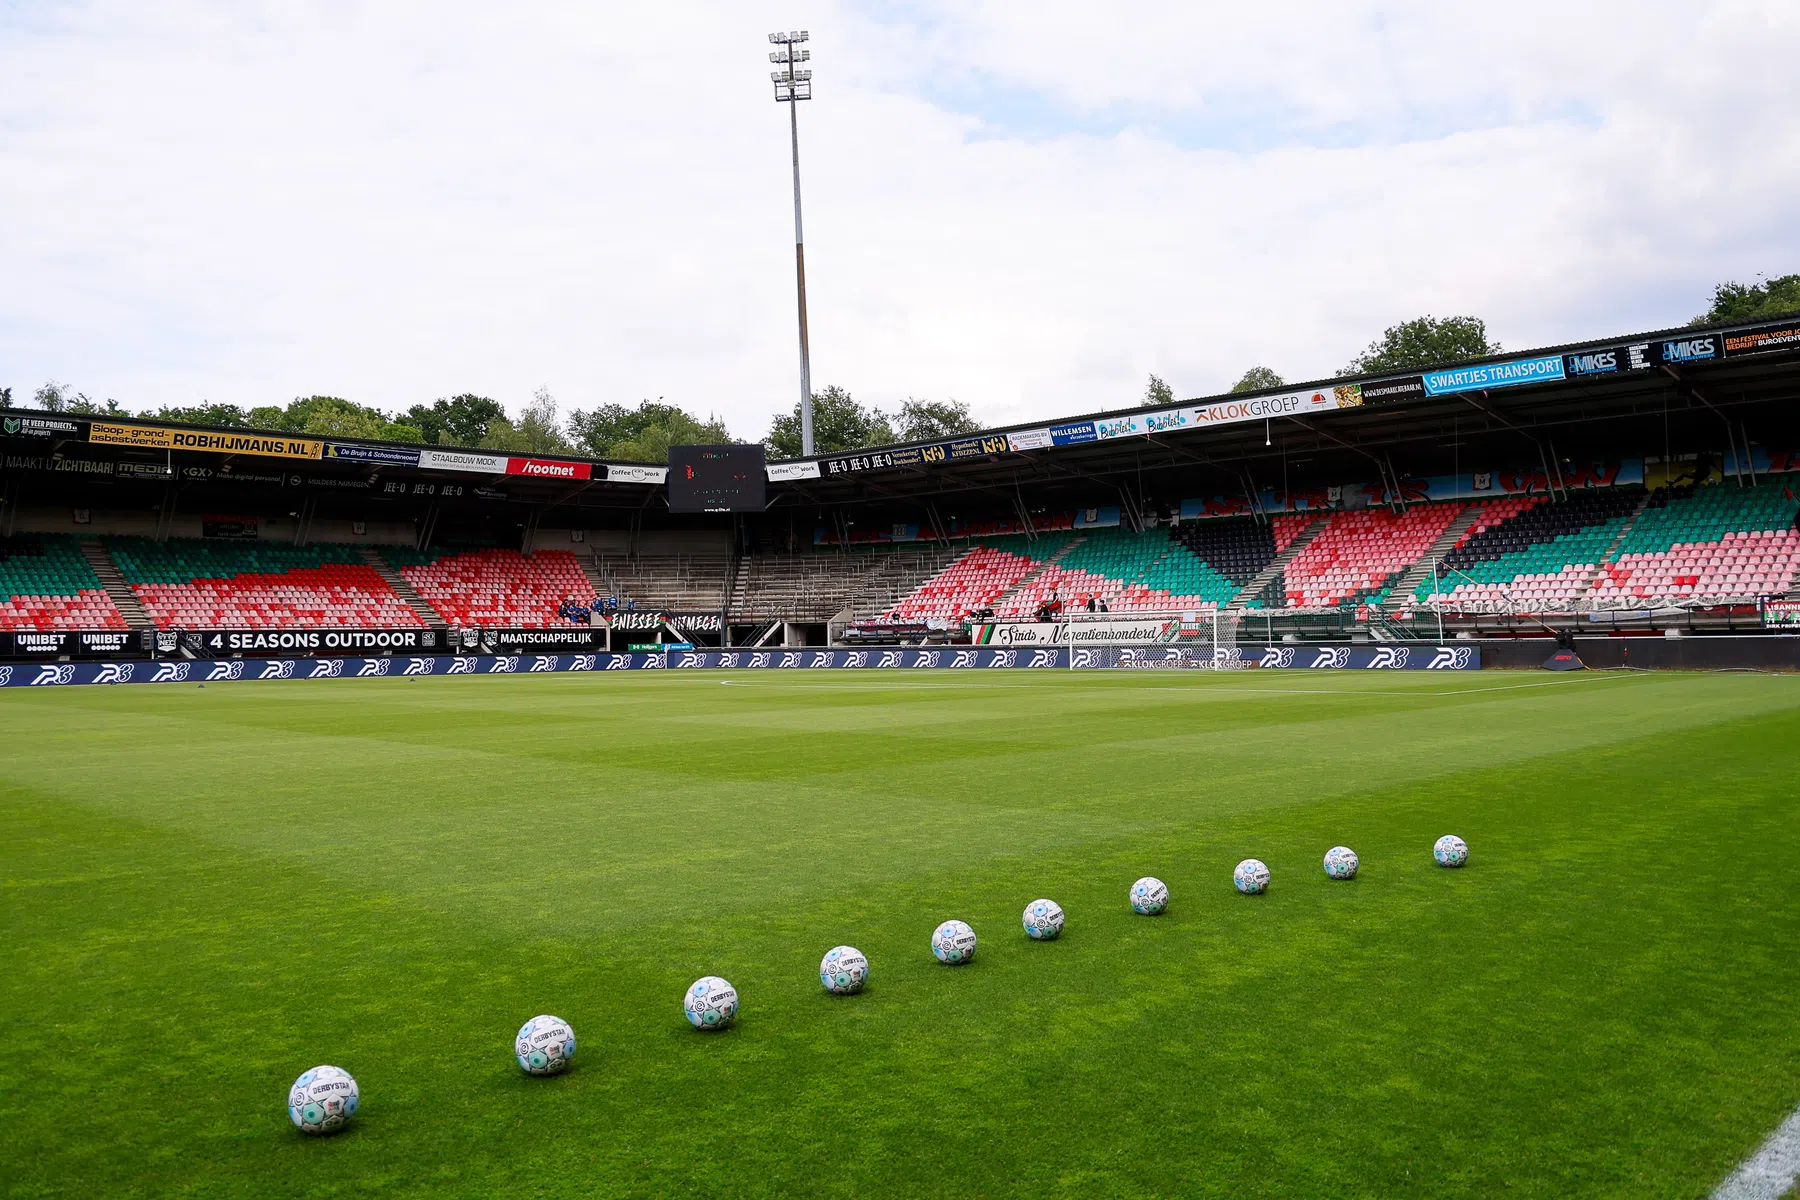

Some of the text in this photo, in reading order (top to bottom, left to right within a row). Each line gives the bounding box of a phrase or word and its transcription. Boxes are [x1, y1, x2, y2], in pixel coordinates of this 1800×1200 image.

[1741, 333, 1769, 342] FESTIVAL
[1771, 329, 1793, 338] VOOR
[1668, 338, 1715, 359] MIKES
[1574, 352, 1617, 372] MIKES
[1430, 359, 1561, 388] SWARTJES TRANSPORT
[22, 418, 30, 426] DE
[30, 419, 45, 428] VEER
[45, 420, 72, 430] PROJECTS
[1051, 425, 1092, 438] WILLEMSEN
[91, 433, 170, 447] asbestwerken
[173, 433, 309, 456] ROBHIJMANS.NL
[6, 455, 44, 470] MAAKT
[432, 454, 497, 466] STAALBOUW MOOK
[17, 634, 67, 646] UNIBET
[82, 633, 129, 645] UNIBET
[210, 634, 223, 648] 4
[229, 632, 320, 648] SEASONS
[325, 632, 416, 648] OUTDOOR
[500, 632, 592, 645] MAATSCHAPPELIJK
[533, 1028, 566, 1044] DERBYSTAR
[312, 1082, 350, 1095] DERBYSTAR
